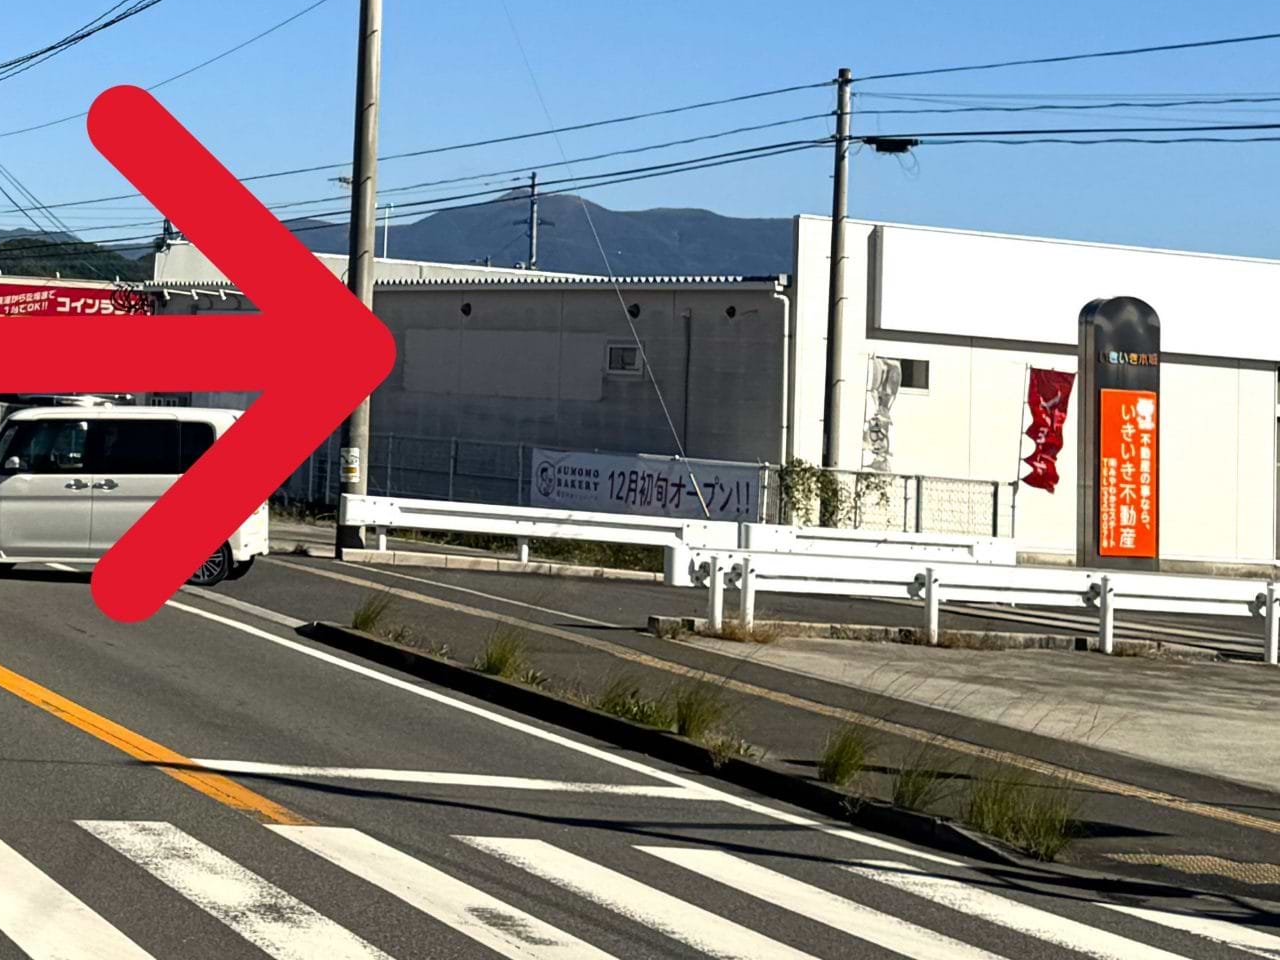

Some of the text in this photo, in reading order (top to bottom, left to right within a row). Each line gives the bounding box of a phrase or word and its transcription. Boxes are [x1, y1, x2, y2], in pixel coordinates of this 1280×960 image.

[608, 469, 751, 514] 12月初旬オープン!!
[1119, 404, 1137, 549] いきいき不動産
